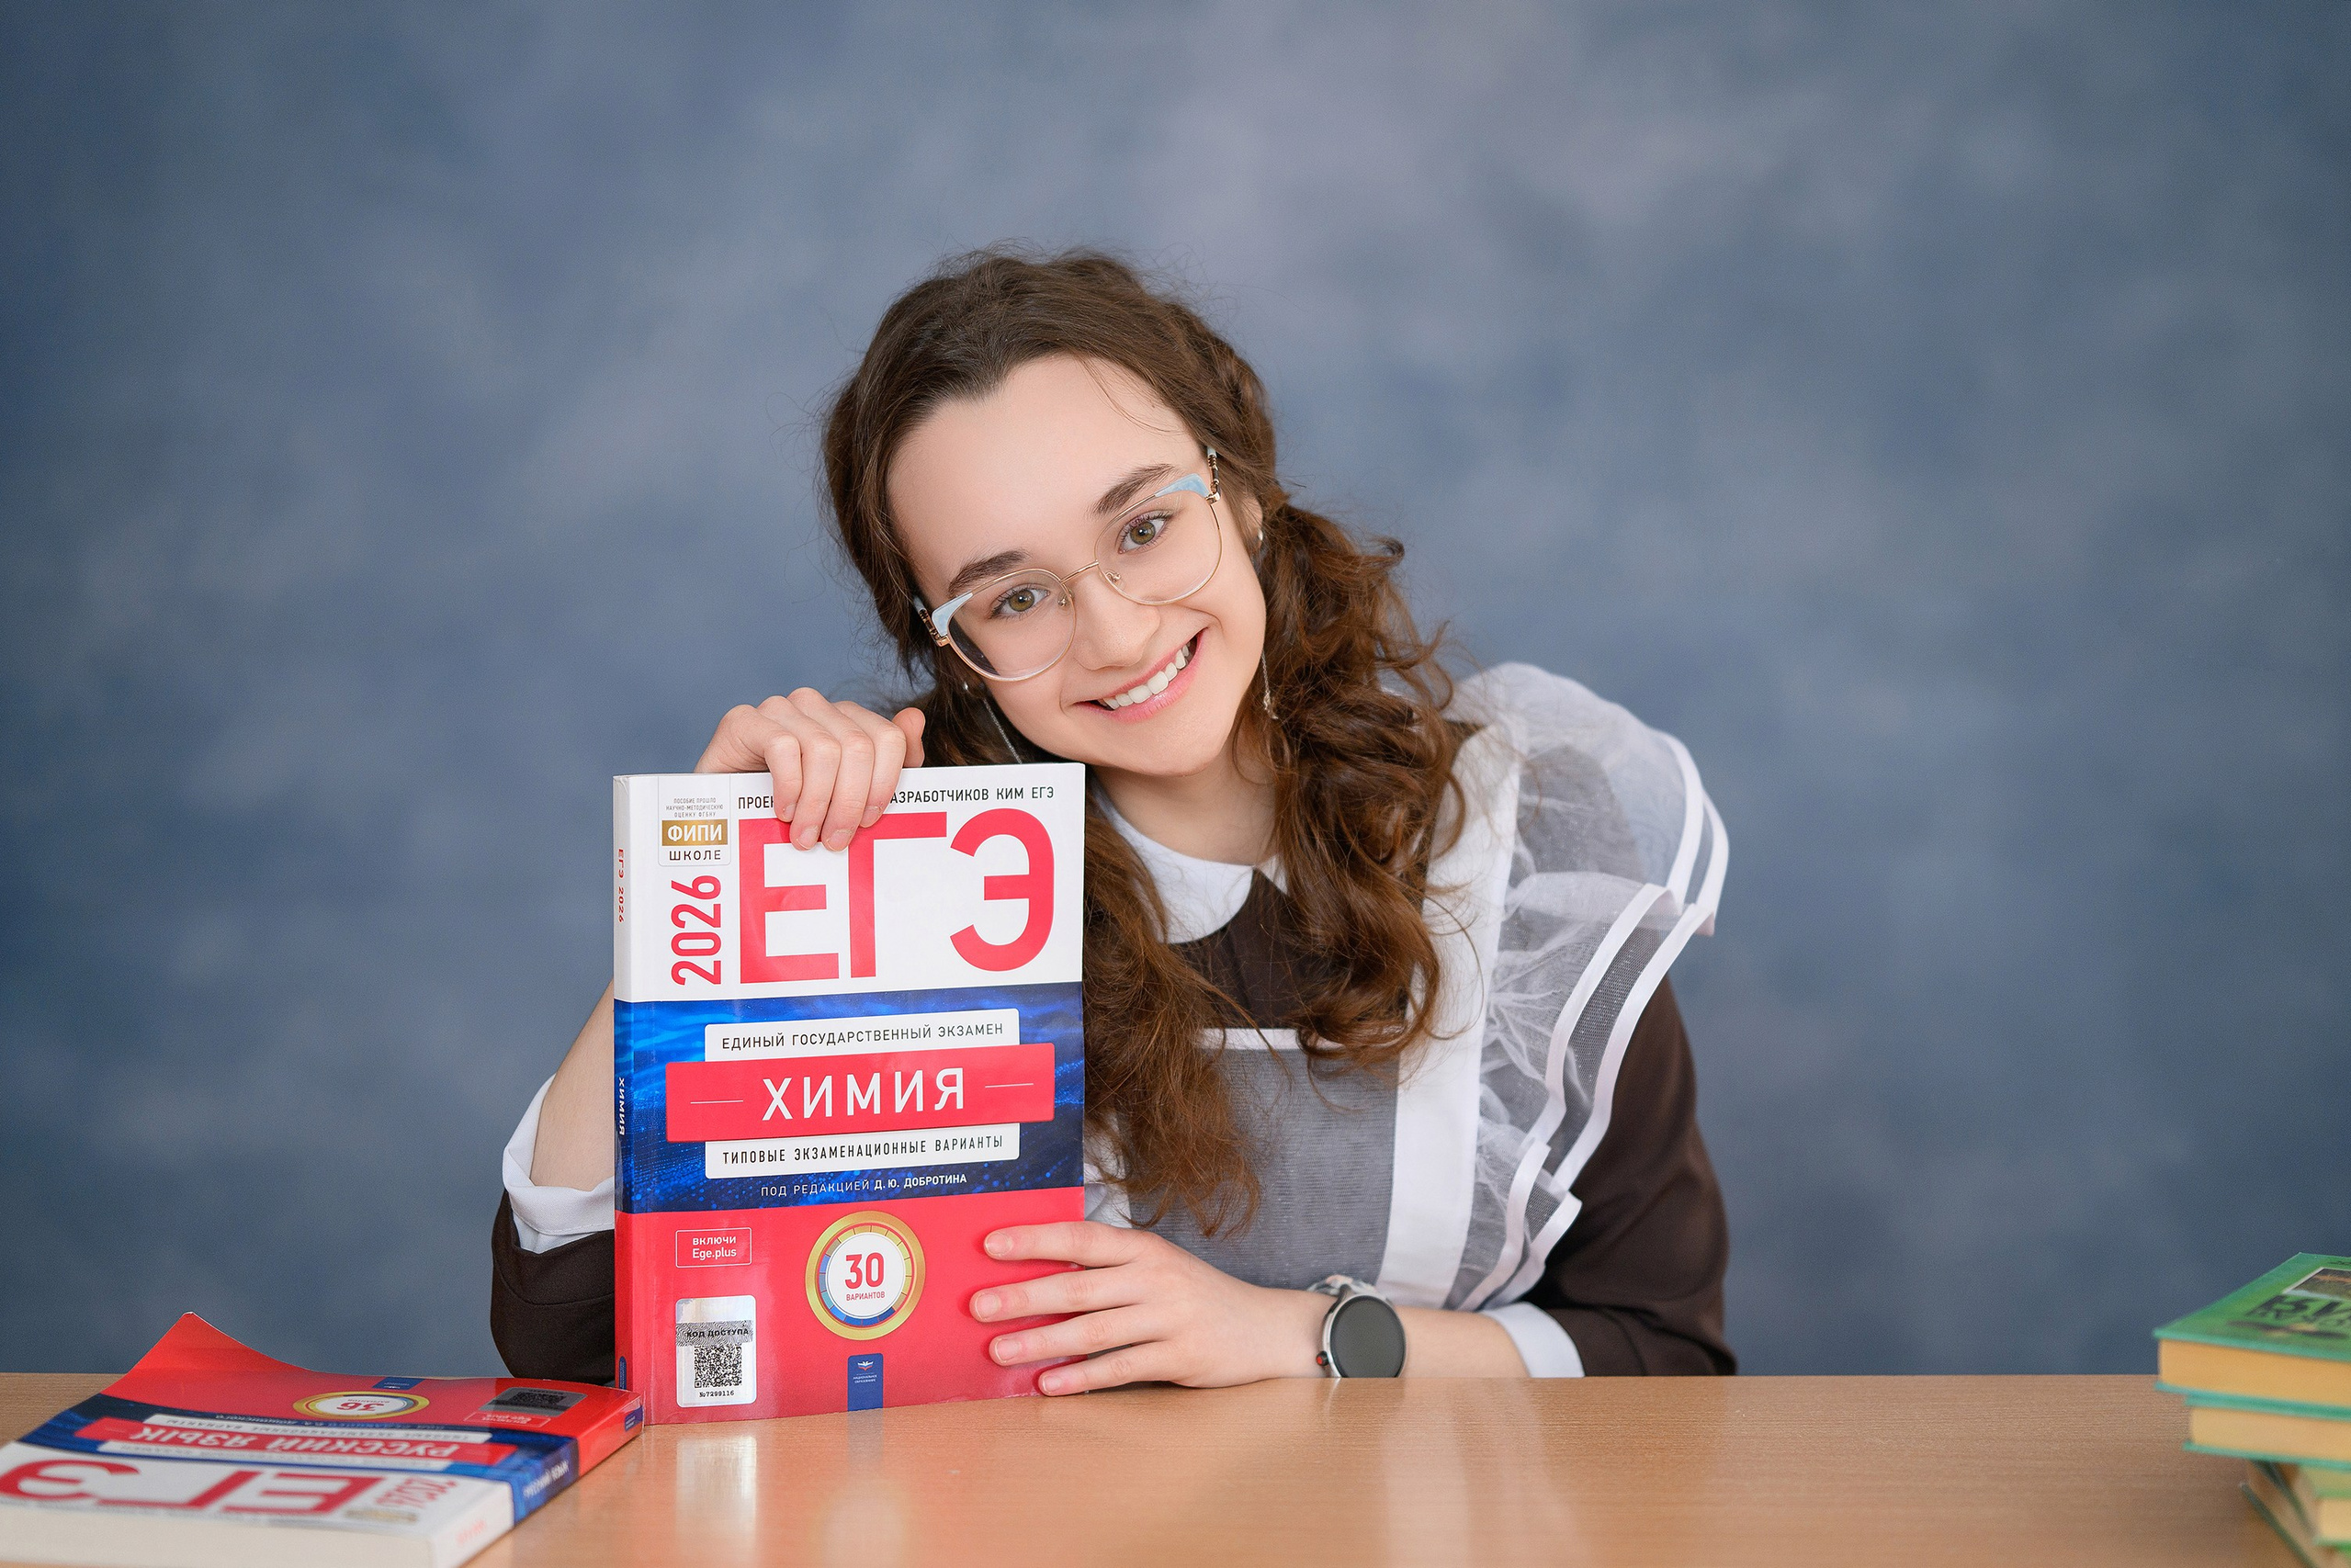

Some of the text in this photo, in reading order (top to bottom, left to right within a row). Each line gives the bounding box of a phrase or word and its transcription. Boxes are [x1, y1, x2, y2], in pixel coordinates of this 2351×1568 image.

[997, 786, 1024, 801] КИМ
[1032, 785, 1055, 799] ЕГЭ
[667, 823, 722, 842] ФИПИ
[669, 850, 721, 861] ШКОЛЕ
[739, 807, 1056, 984] ЕГЭ
[671, 875, 721, 986] 2026
[722, 1023, 1003, 1051] ЕДИНЫЙ ГОСУДАРСТВЕННЫЙ ЭКЗАМЕН
[762, 1067, 964, 1121] ХИМИЯ
[723, 1134, 1004, 1165] ТИПОВЫЕ ЭКЗАМЕНАЦИОННЫЕ ВАРИАНТЫ
[761, 1186, 787, 1197] ПОД
[794, 1179, 870, 1195] РЕДАКЦИЕЙ
[904, 1174, 967, 1189] ДОБРОТИНА
[692, 1247, 737, 1261] Ege.plus
[845, 1252, 884, 1289] 30
[846, 1292, 886, 1301] ВАРИАНТОВ
[686, 1328, 749, 1338] КОД ДОСТУПА
[336, 1402, 384, 1412] 36
[130, 1427, 258, 1448] ЯЗЫК
[265, 1436, 460, 1459] РУССКИЙ
[0, 1459, 387, 1514] ЕГЭ
